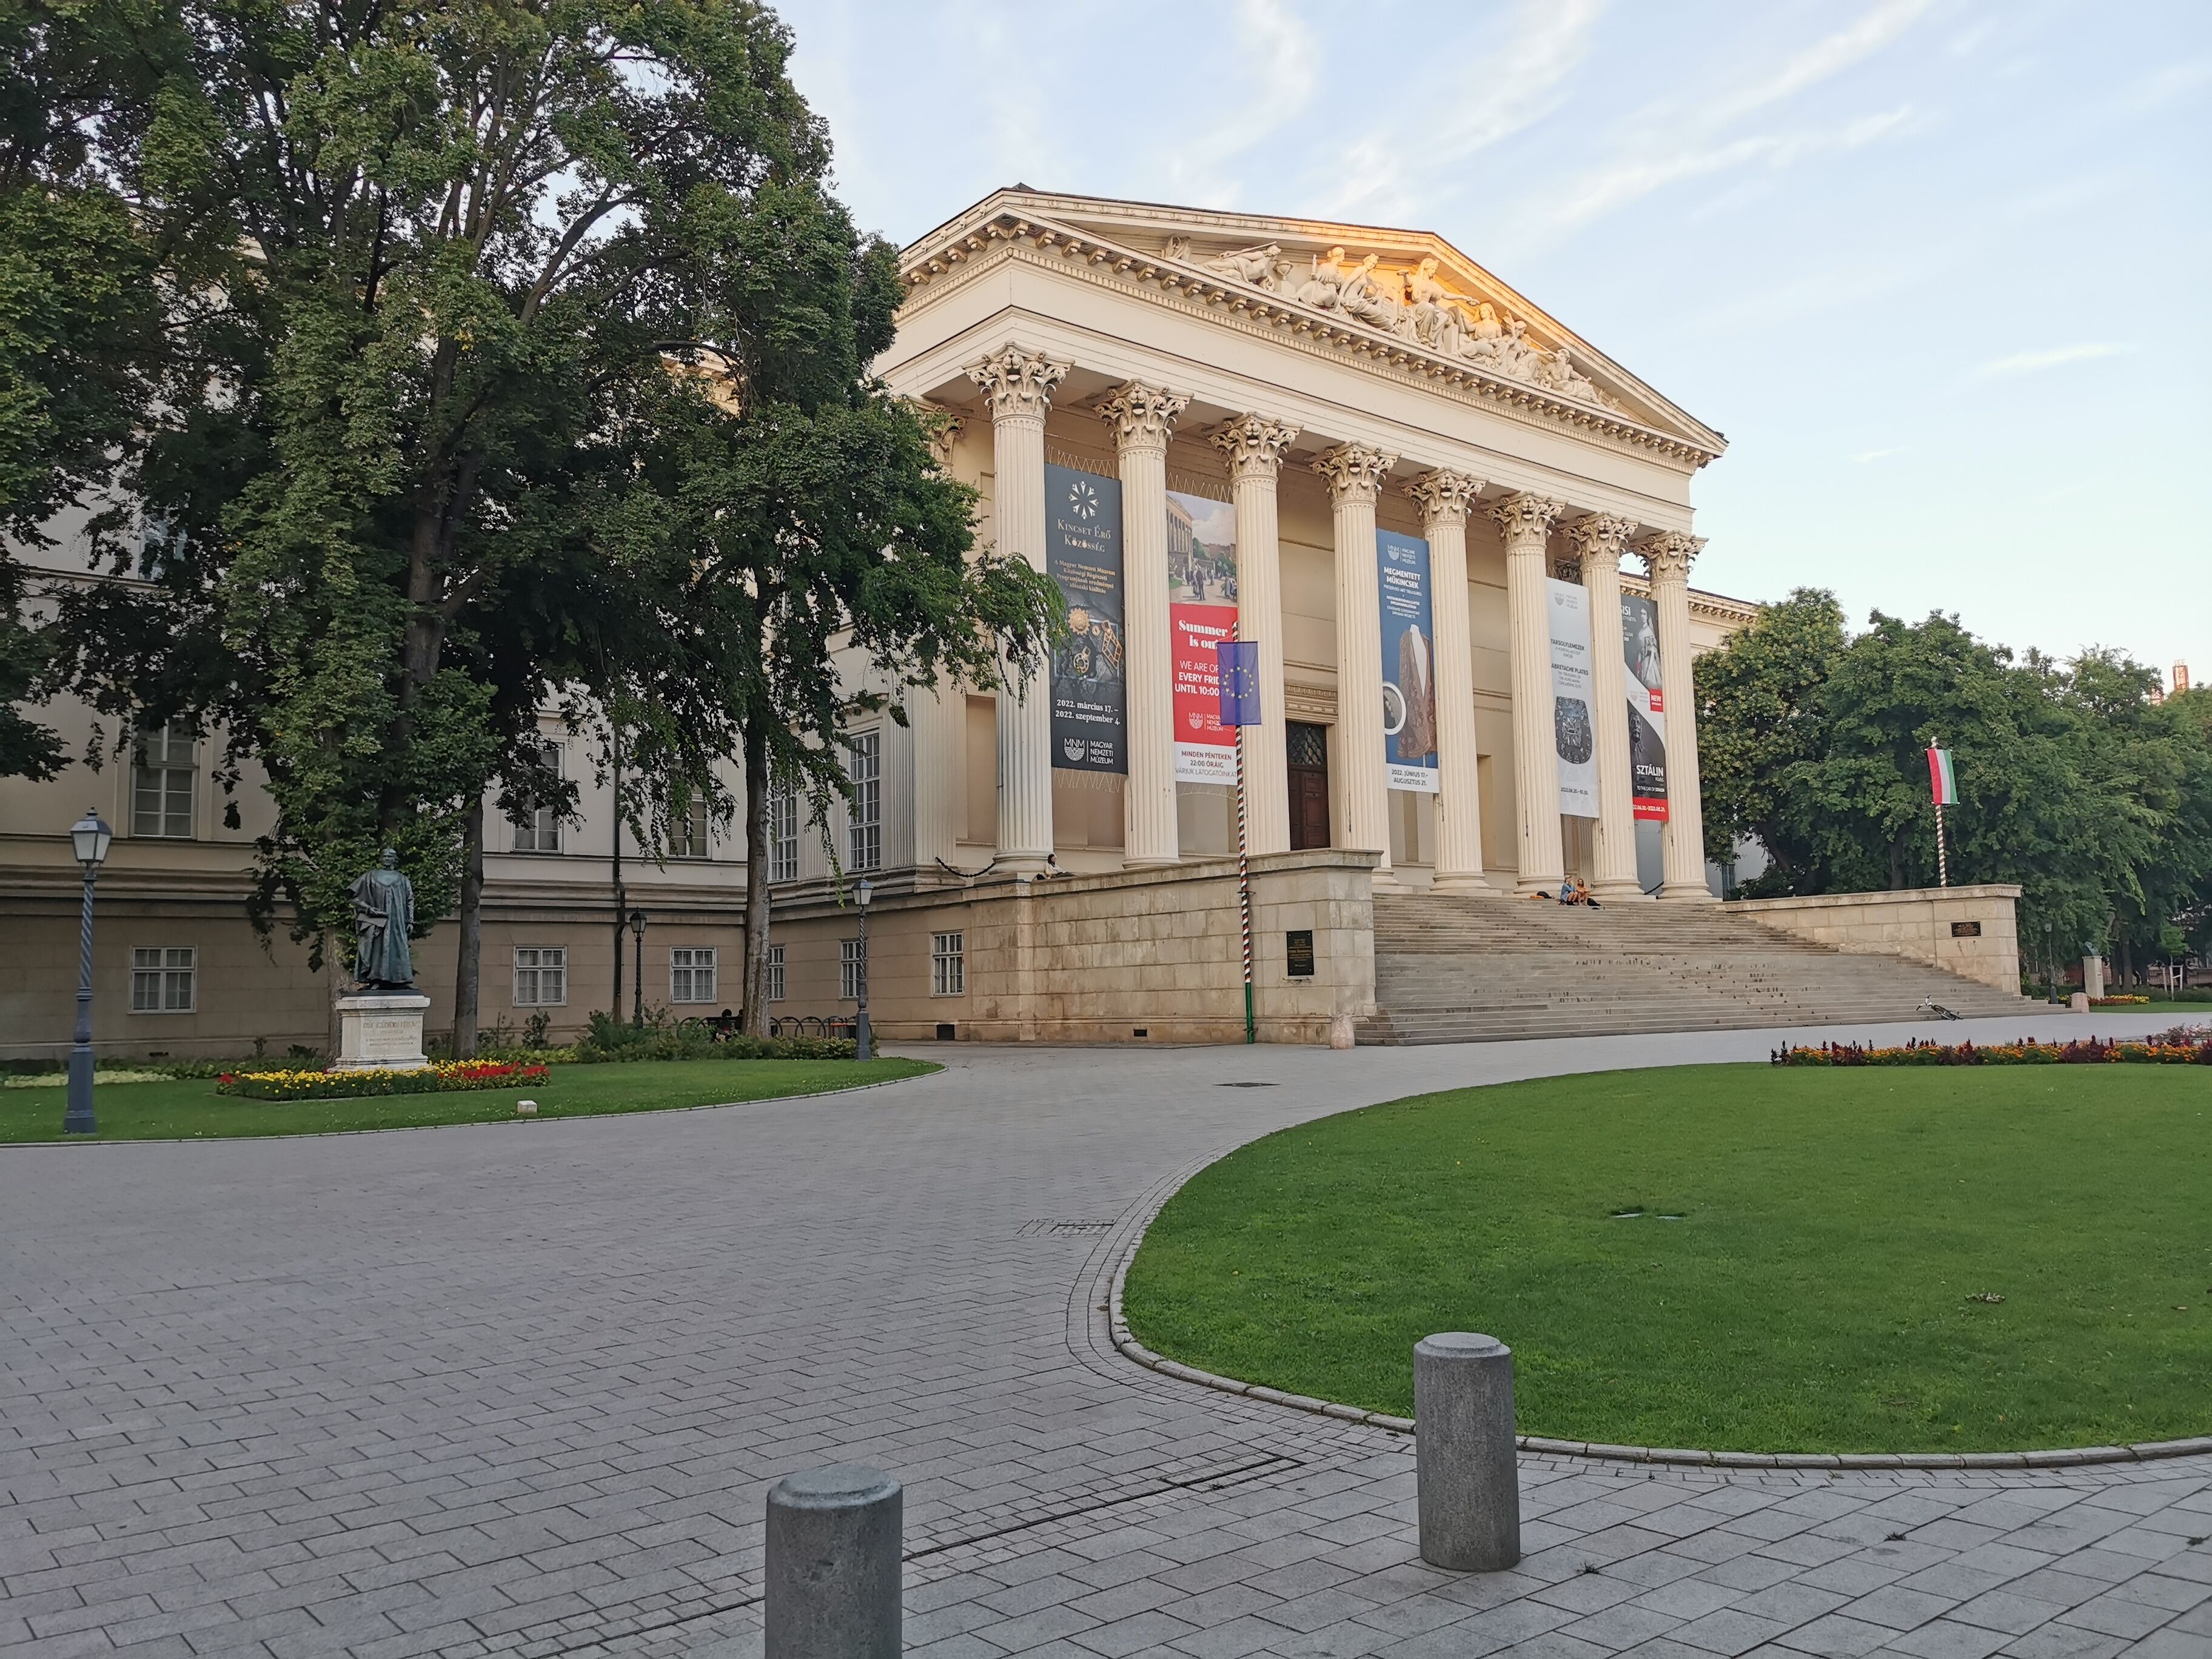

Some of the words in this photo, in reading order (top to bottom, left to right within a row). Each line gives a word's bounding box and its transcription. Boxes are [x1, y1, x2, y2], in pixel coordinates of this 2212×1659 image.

[1384, 566, 1421, 581] MEGMENTETT
[1621, 605, 1631, 616] ISI
[1178, 620, 1228, 637] Summer
[1189, 634, 1199, 648] is
[1179, 660, 1192, 670] WE
[1193, 662, 1208, 672] ARE
[1551, 663, 1574, 673] ABRETACHE
[1575, 668, 1589, 676] PLATES
[1179, 672, 1202, 683] EVERY
[1175, 683, 1198, 694] UNTIL
[1199, 686, 1219, 697] 10:00
[1651, 694, 1661, 703] NEW
[1056, 699, 1076, 708] 2022.
[1077, 701, 1103, 711] március
[1104, 705, 1113, 713] 17.
[1055, 710, 1074, 719] 2022.
[1075, 713, 1113, 723] szeptember
[1114, 717, 1121, 726] 4.
[1064, 737, 1085, 748] MNM
[1090, 740, 1113, 749] MAGYAR
[1090, 748, 1113, 757] NEMZETI
[1205, 751, 1232, 760] PÉNTEKEN
[1090, 756, 1113, 765] MÚZEUM
[1636, 764, 1664, 777] SZTÁLIN
[1393, 777, 1420, 785] AUGUSZTUS
